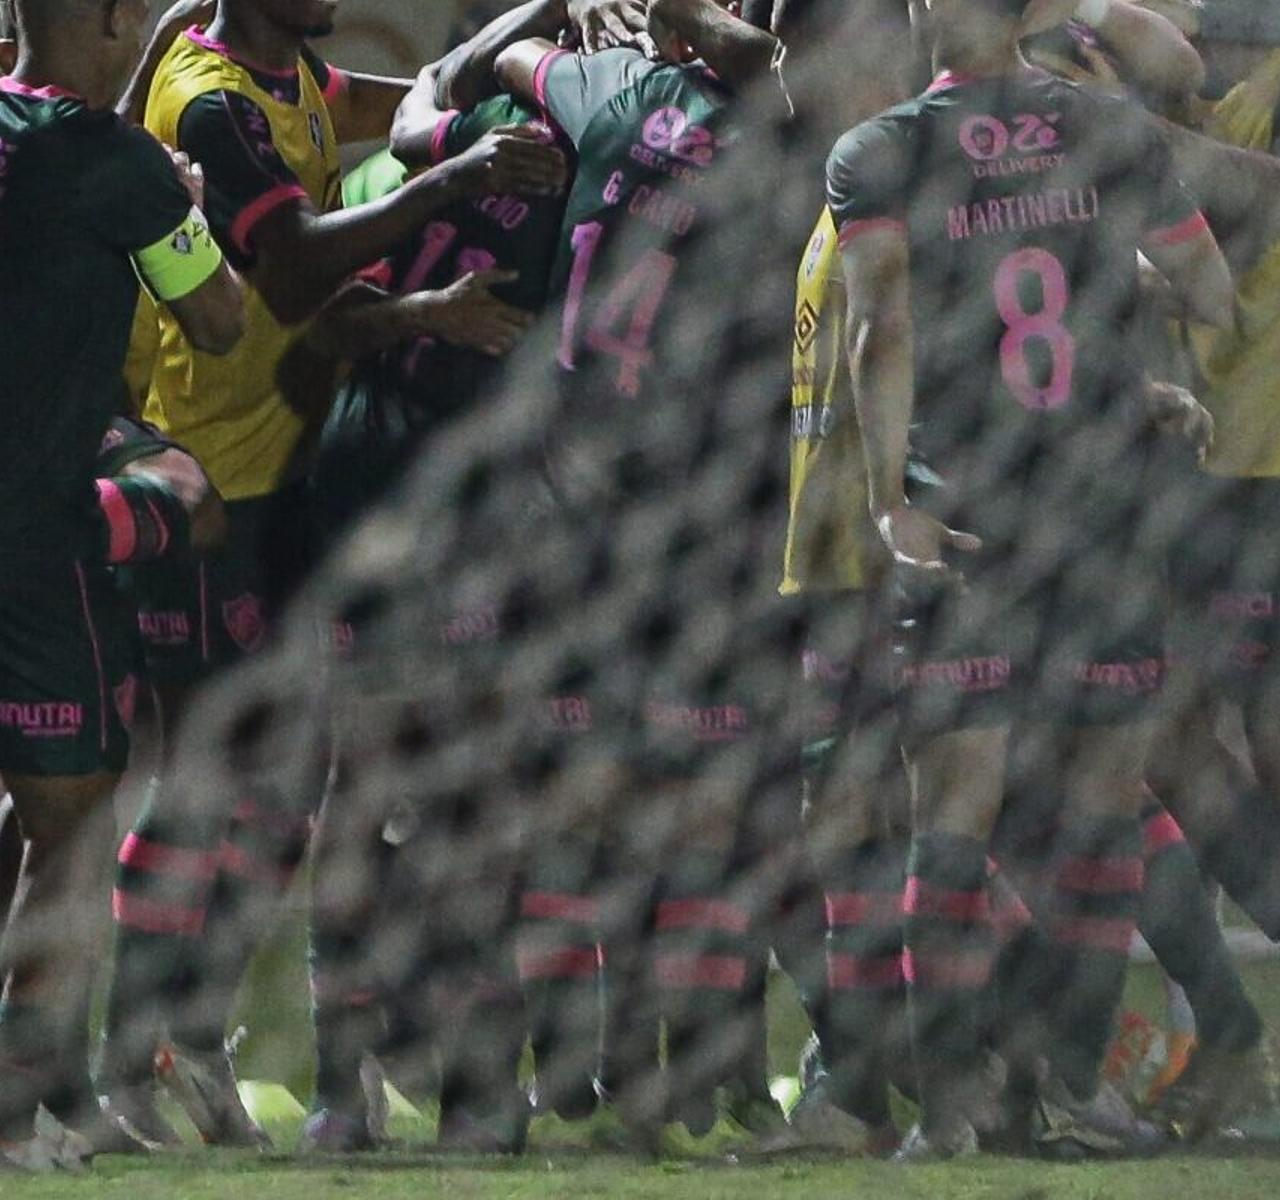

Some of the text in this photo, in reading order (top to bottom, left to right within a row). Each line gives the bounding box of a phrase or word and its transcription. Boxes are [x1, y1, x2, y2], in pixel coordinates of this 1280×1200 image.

[945, 187, 1101, 241] MARTINELLI
[972, 152, 1068, 179] DELIVERY
[556, 220, 678, 398] 14
[992, 246, 1075, 411] 8
